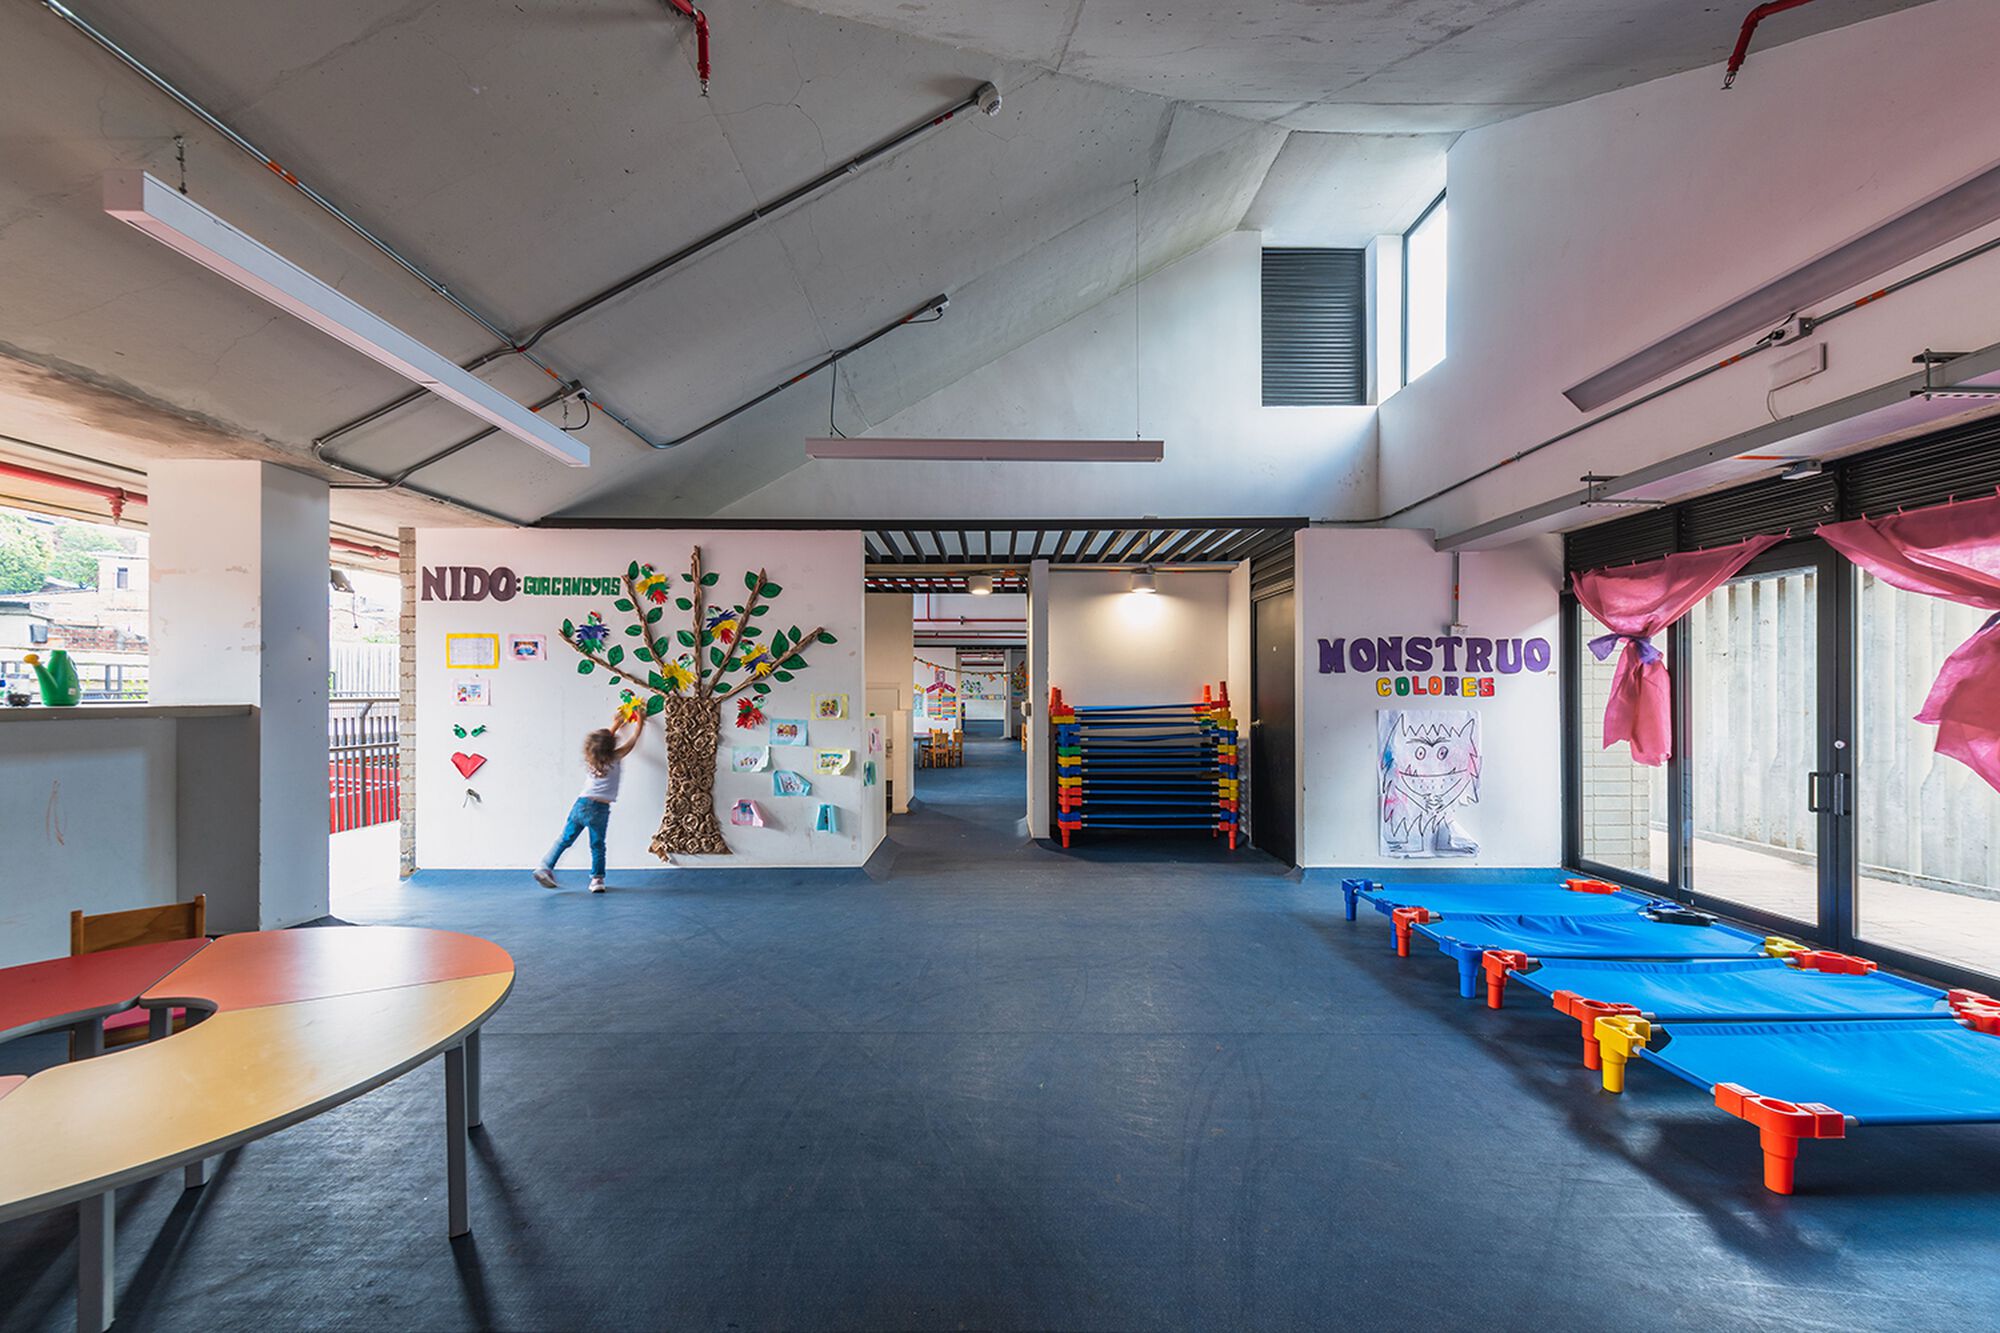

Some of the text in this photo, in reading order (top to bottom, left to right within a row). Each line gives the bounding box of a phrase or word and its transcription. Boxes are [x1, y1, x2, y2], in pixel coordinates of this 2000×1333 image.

[421, 566, 521, 602] NIDO:
[1318, 636, 1551, 674] MONSTRUO
[1376, 676, 1495, 697] COLORES
